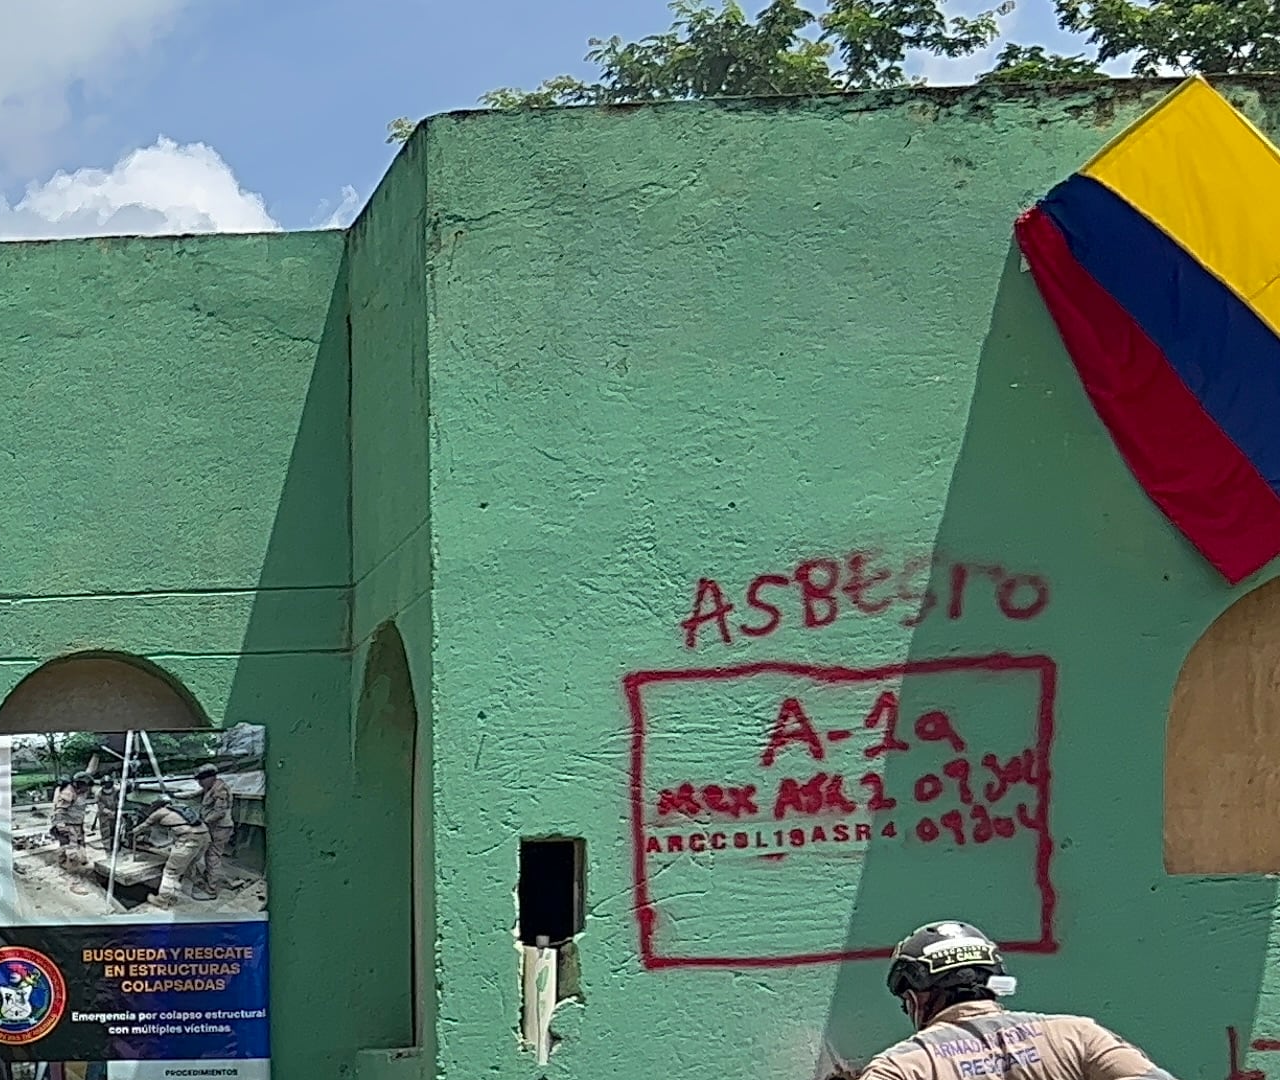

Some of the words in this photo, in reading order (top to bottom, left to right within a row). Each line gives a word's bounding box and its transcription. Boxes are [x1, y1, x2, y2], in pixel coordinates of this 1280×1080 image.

[860, 771, 898, 811] 2
[83, 949, 167, 962] BUSQUEDA
[168, 948, 180, 960] Y
[184, 947, 253, 960] RESCATE
[104, 964, 125, 977] EN
[129, 962, 240, 976] ESTRUCTURAS
[121, 979, 226, 992] COLAPSADAS
[71, 1011, 136, 1023] Emergencia
[138, 1012, 157, 1022] por
[159, 1010, 202, 1021] colapso
[204, 1008, 266, 1019] estructural
[108, 1026, 129, 1034] con
[131, 1023, 182, 1035] múltiples
